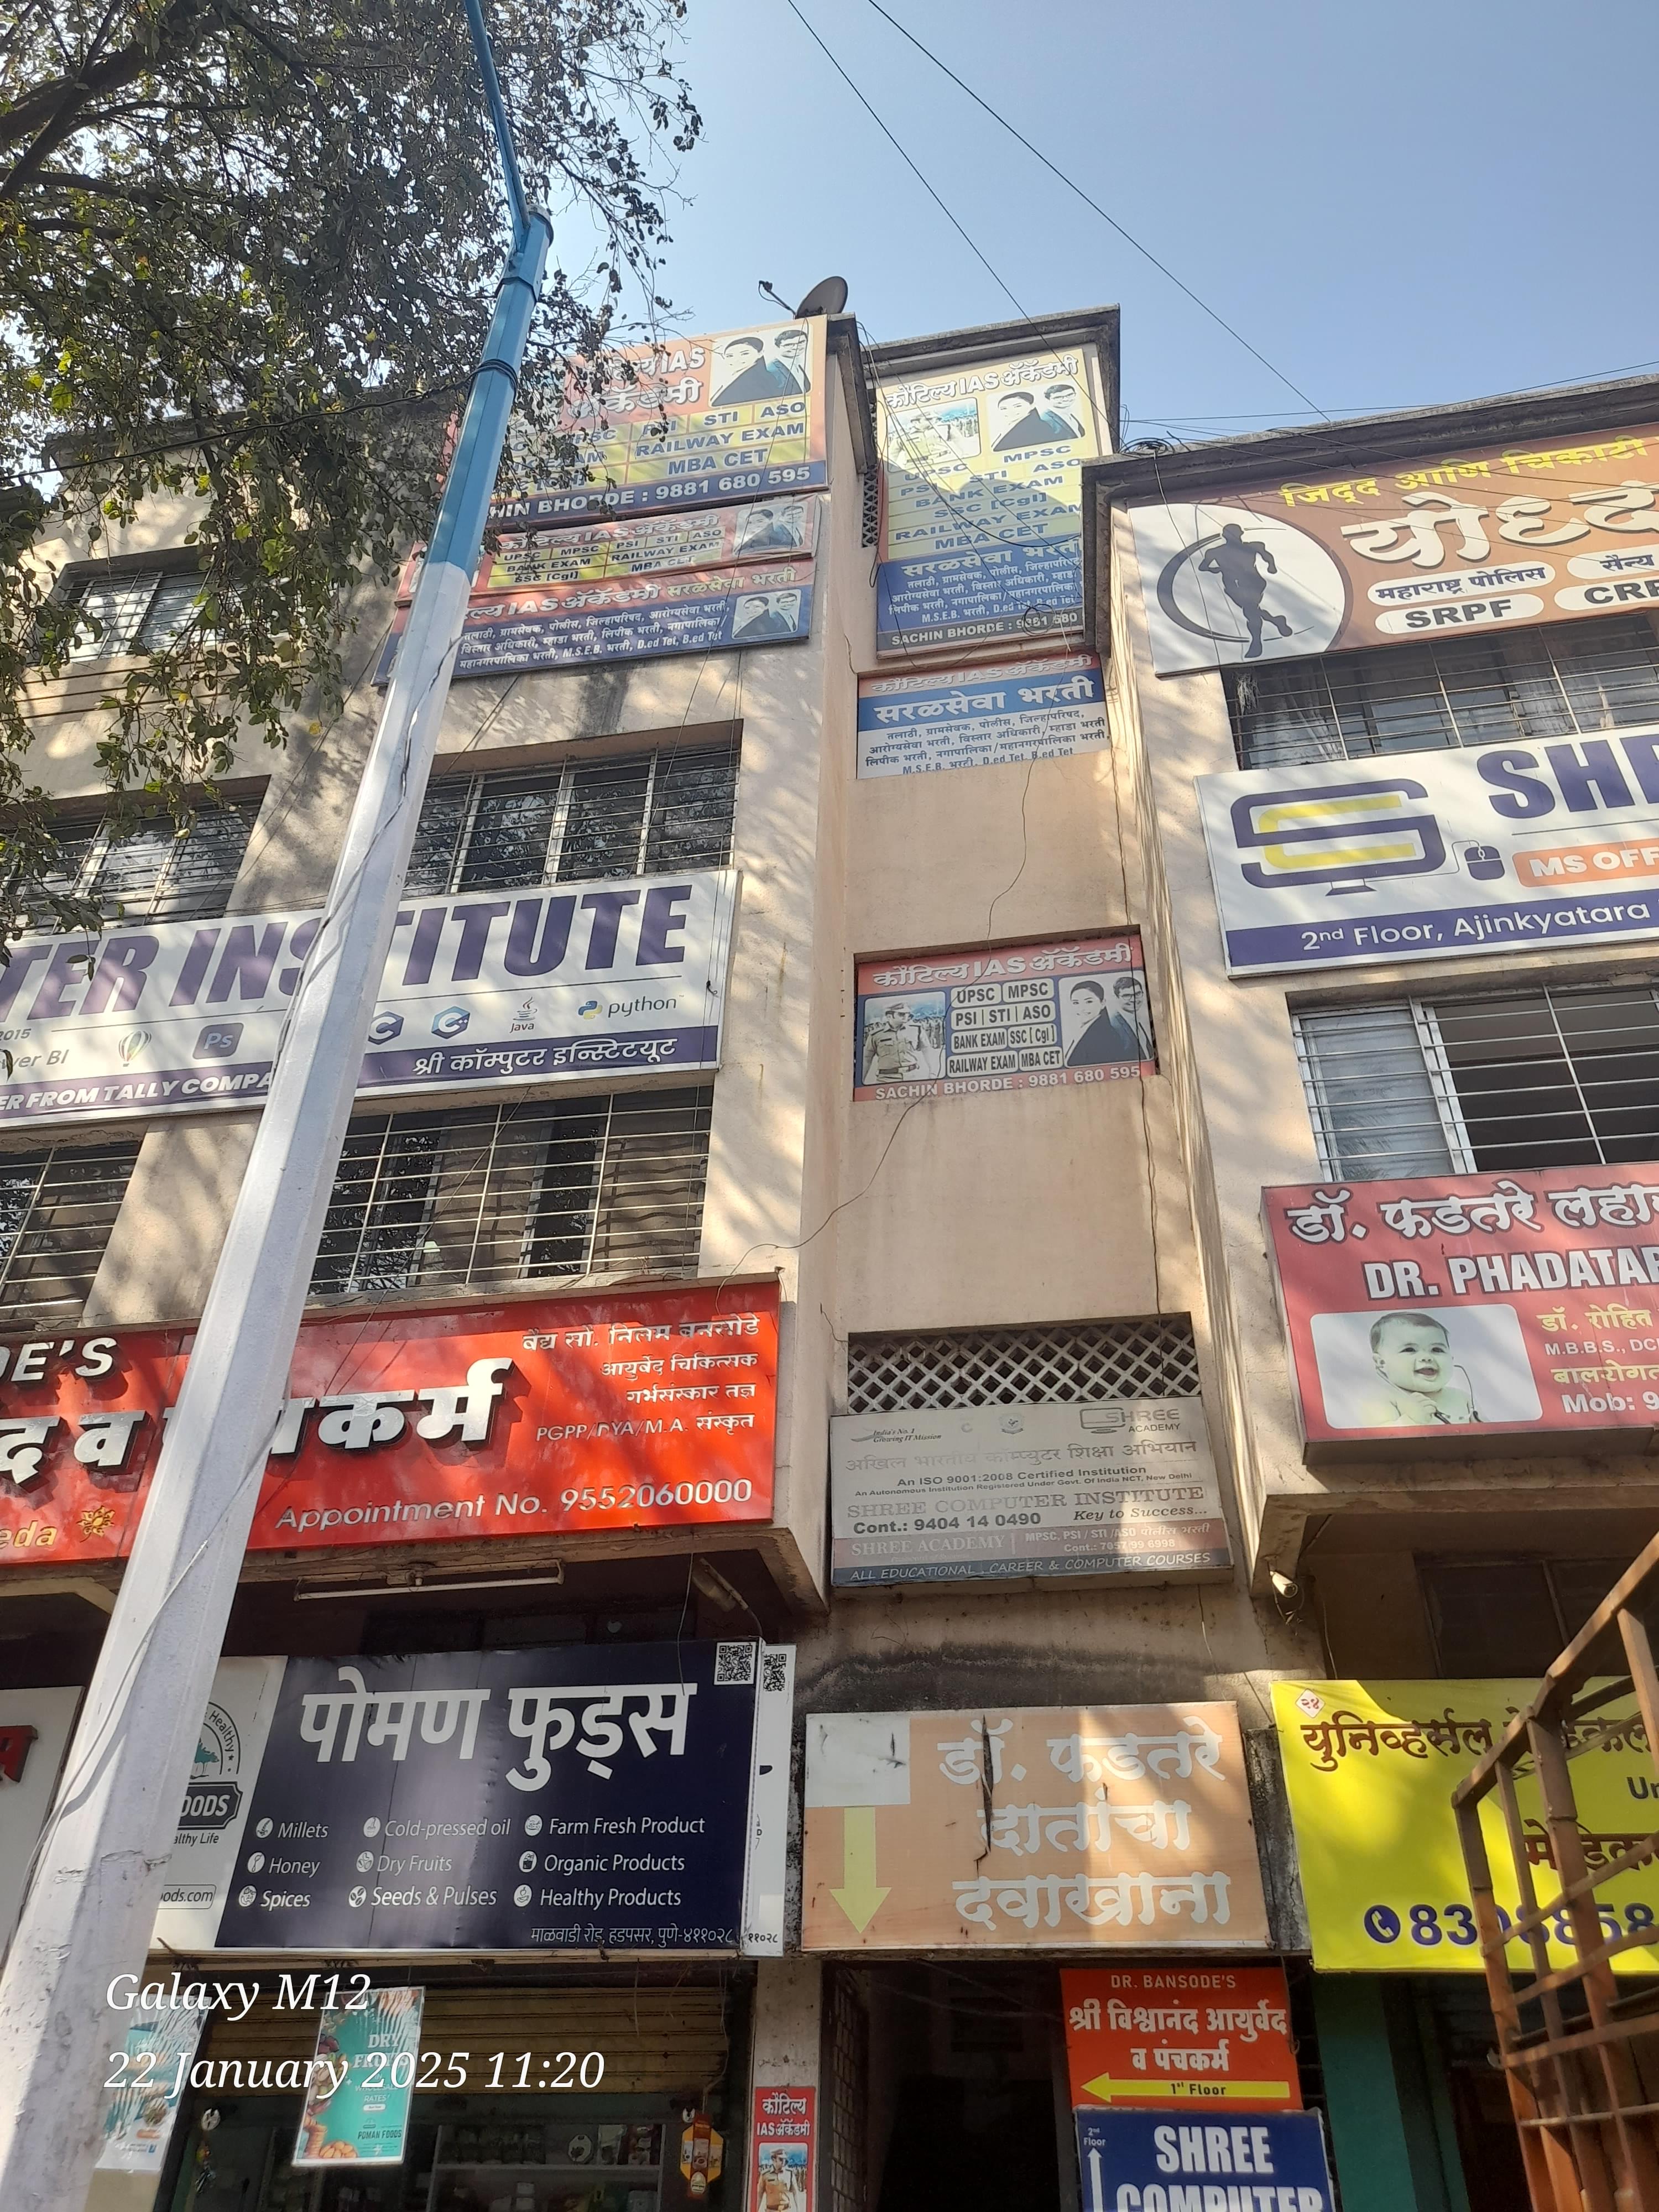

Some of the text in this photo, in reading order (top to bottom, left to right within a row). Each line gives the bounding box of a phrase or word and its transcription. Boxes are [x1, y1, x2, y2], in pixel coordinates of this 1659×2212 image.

[959, 372, 1000, 395] IAS
[704, 401, 806, 426] STI ASO
[635, 422, 805, 457] RAILWAY EXAM
[668, 448, 769, 476] MBA CET
[1004, 445, 1072, 463] MPSC
[1392, 434, 1649, 492] आणि चिकाटी
[655, 467, 811, 500] 9881 680 595
[993, 476, 1063, 494] EXAM
[935, 523, 1048, 550] MBA CET
[1467, 560, 1547, 589] पोलिस
[1599, 554, 1655, 572] सैन्य
[752, 568, 797, 587] भरती
[1404, 598, 1514, 630] SRPF
[873, 675, 1095, 723] सरळसेवा भरती
[979, 717, 1015, 729] पोलीस,
[1300, 901, 1650, 951] 2nd Floor, Ajinkyatara
[973, 956, 1026, 978] IAS
[957, 982, 1049, 1004] UPSC MPSC
[608, 996, 677, 1019] python
[956, 1005, 1051, 1026] PSI STI ASO
[204, 1031, 234, 1050] Ps
[953, 1029, 1027, 1049] BANK EXAM SSC
[413, 1052, 446, 1076] श्री
[450, 1047, 549, 1075] कॉम्पुटर
[949, 1050, 1061, 1073] RAILWAY EXAM MBA CET
[25, 1081, 181, 1108] FROM TALLY
[875, 1065, 1141, 1101] SACHIN BHORDE 9881 680 595
[1287, 1179, 1543, 1244] डॉ. फडतरे
[1363, 1259, 1441, 1300] DR.
[1536, 1303, 1653, 1332] डॉ. रोहित
[608, 1321, 672, 1345] निलम
[670, 1350, 758, 1373] चिकित्सक
[725, 1383, 757, 1399] तज्ञ
[1562, 1392, 1635, 1413] Mob:
[696, 1410, 755, 1436] संस्कृत
[1128, 1423, 1181, 1433] ACADEMY
[846, 1454, 906, 1470] अखिल
[1067, 1443, 1114, 1459] शिक्षा
[1121, 1439, 1197, 1455] अभियान
[920, 1477, 943, 1485] ISO
[947, 1473, 1013, 1484] 9001:2008
[1018, 1468, 1074, 1480] Certified
[1078, 1465, 1147, 1477] Institution
[275, 1478, 753, 1533] Appointment No. 9552060000
[847, 1486, 1204, 1517] SHREE COMPUTER INSTITUTE
[853, 1509, 1125, 1534] Cont.: 9404 14 0490 Key to
[850, 1552, 1211, 1580] ALL EDUCATIONAL CAREER & COMPUTER COURSES
[300, 1665, 492, 1763] पोमण
[208, 1710, 234, 1752] Healthy
[937, 1715, 1227, 1787] डॉ. फडतरे
[277, 1822, 329, 1839] Millets
[384, 1818, 511, 1841] Cold-pressed oil
[549, 1817, 706, 1835] Farm Fresh Product
[977, 1787, 1193, 1858] दातांचा
[200, 1833, 219, 1844] Life
[269, 1857, 321, 1878] Honey
[377, 1854, 453, 1875] Dry Fruits
[544, 1854, 686, 1876] Organic Products
[260, 1890, 311, 1911] Spices
[371, 1886, 497, 1907] Seeds & Pulses
[540, 1888, 682, 1910] Healthy Products
[952, 1870, 1232, 1932] दवाखाना
[531, 1923, 581, 1943] माळवाडी
[608, 1927, 655, 1944] हडपसर,
[1110, 1974, 1237, 1989] DR. BANSODE'S
[1069, 1998, 1287, 2042] श्री विश्वानंद आयुर्वेद
[367, 2033, 400, 2048] DRY
[1130, 2037, 1230, 2072] व पंचकर्म
[1170, 2081, 1227, 2095] 1st Floor
[757, 2122, 774, 2136] IAS
[1083, 2137, 1107, 2147] Floor
[1154, 2125, 1275, 2174] SHREE
